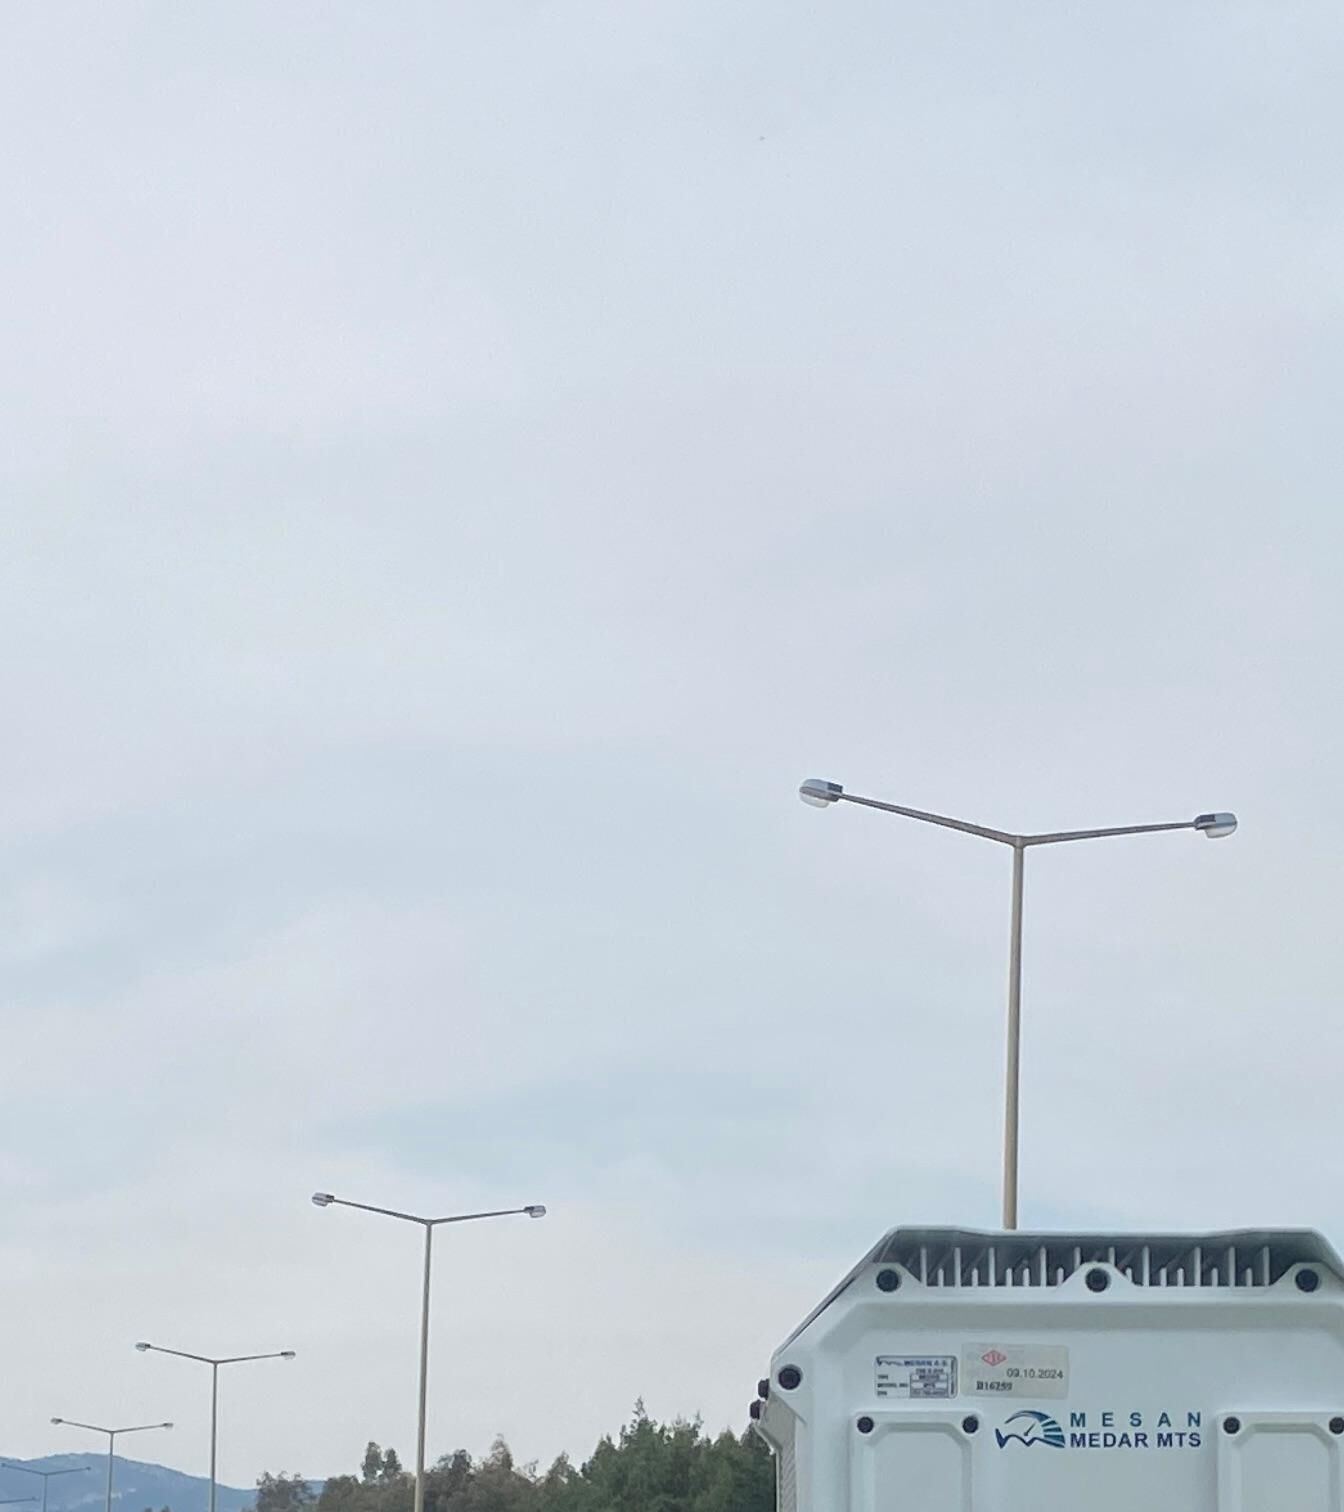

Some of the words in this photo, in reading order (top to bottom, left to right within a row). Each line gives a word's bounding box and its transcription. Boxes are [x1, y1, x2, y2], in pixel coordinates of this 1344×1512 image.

[1006, 1367, 1063, 1380] 09.10.2024
[1070, 1412, 1201, 1428] MESAN
[1070, 1432, 1149, 1449] MEDAR
[1157, 1432, 1202, 1448] MTS
